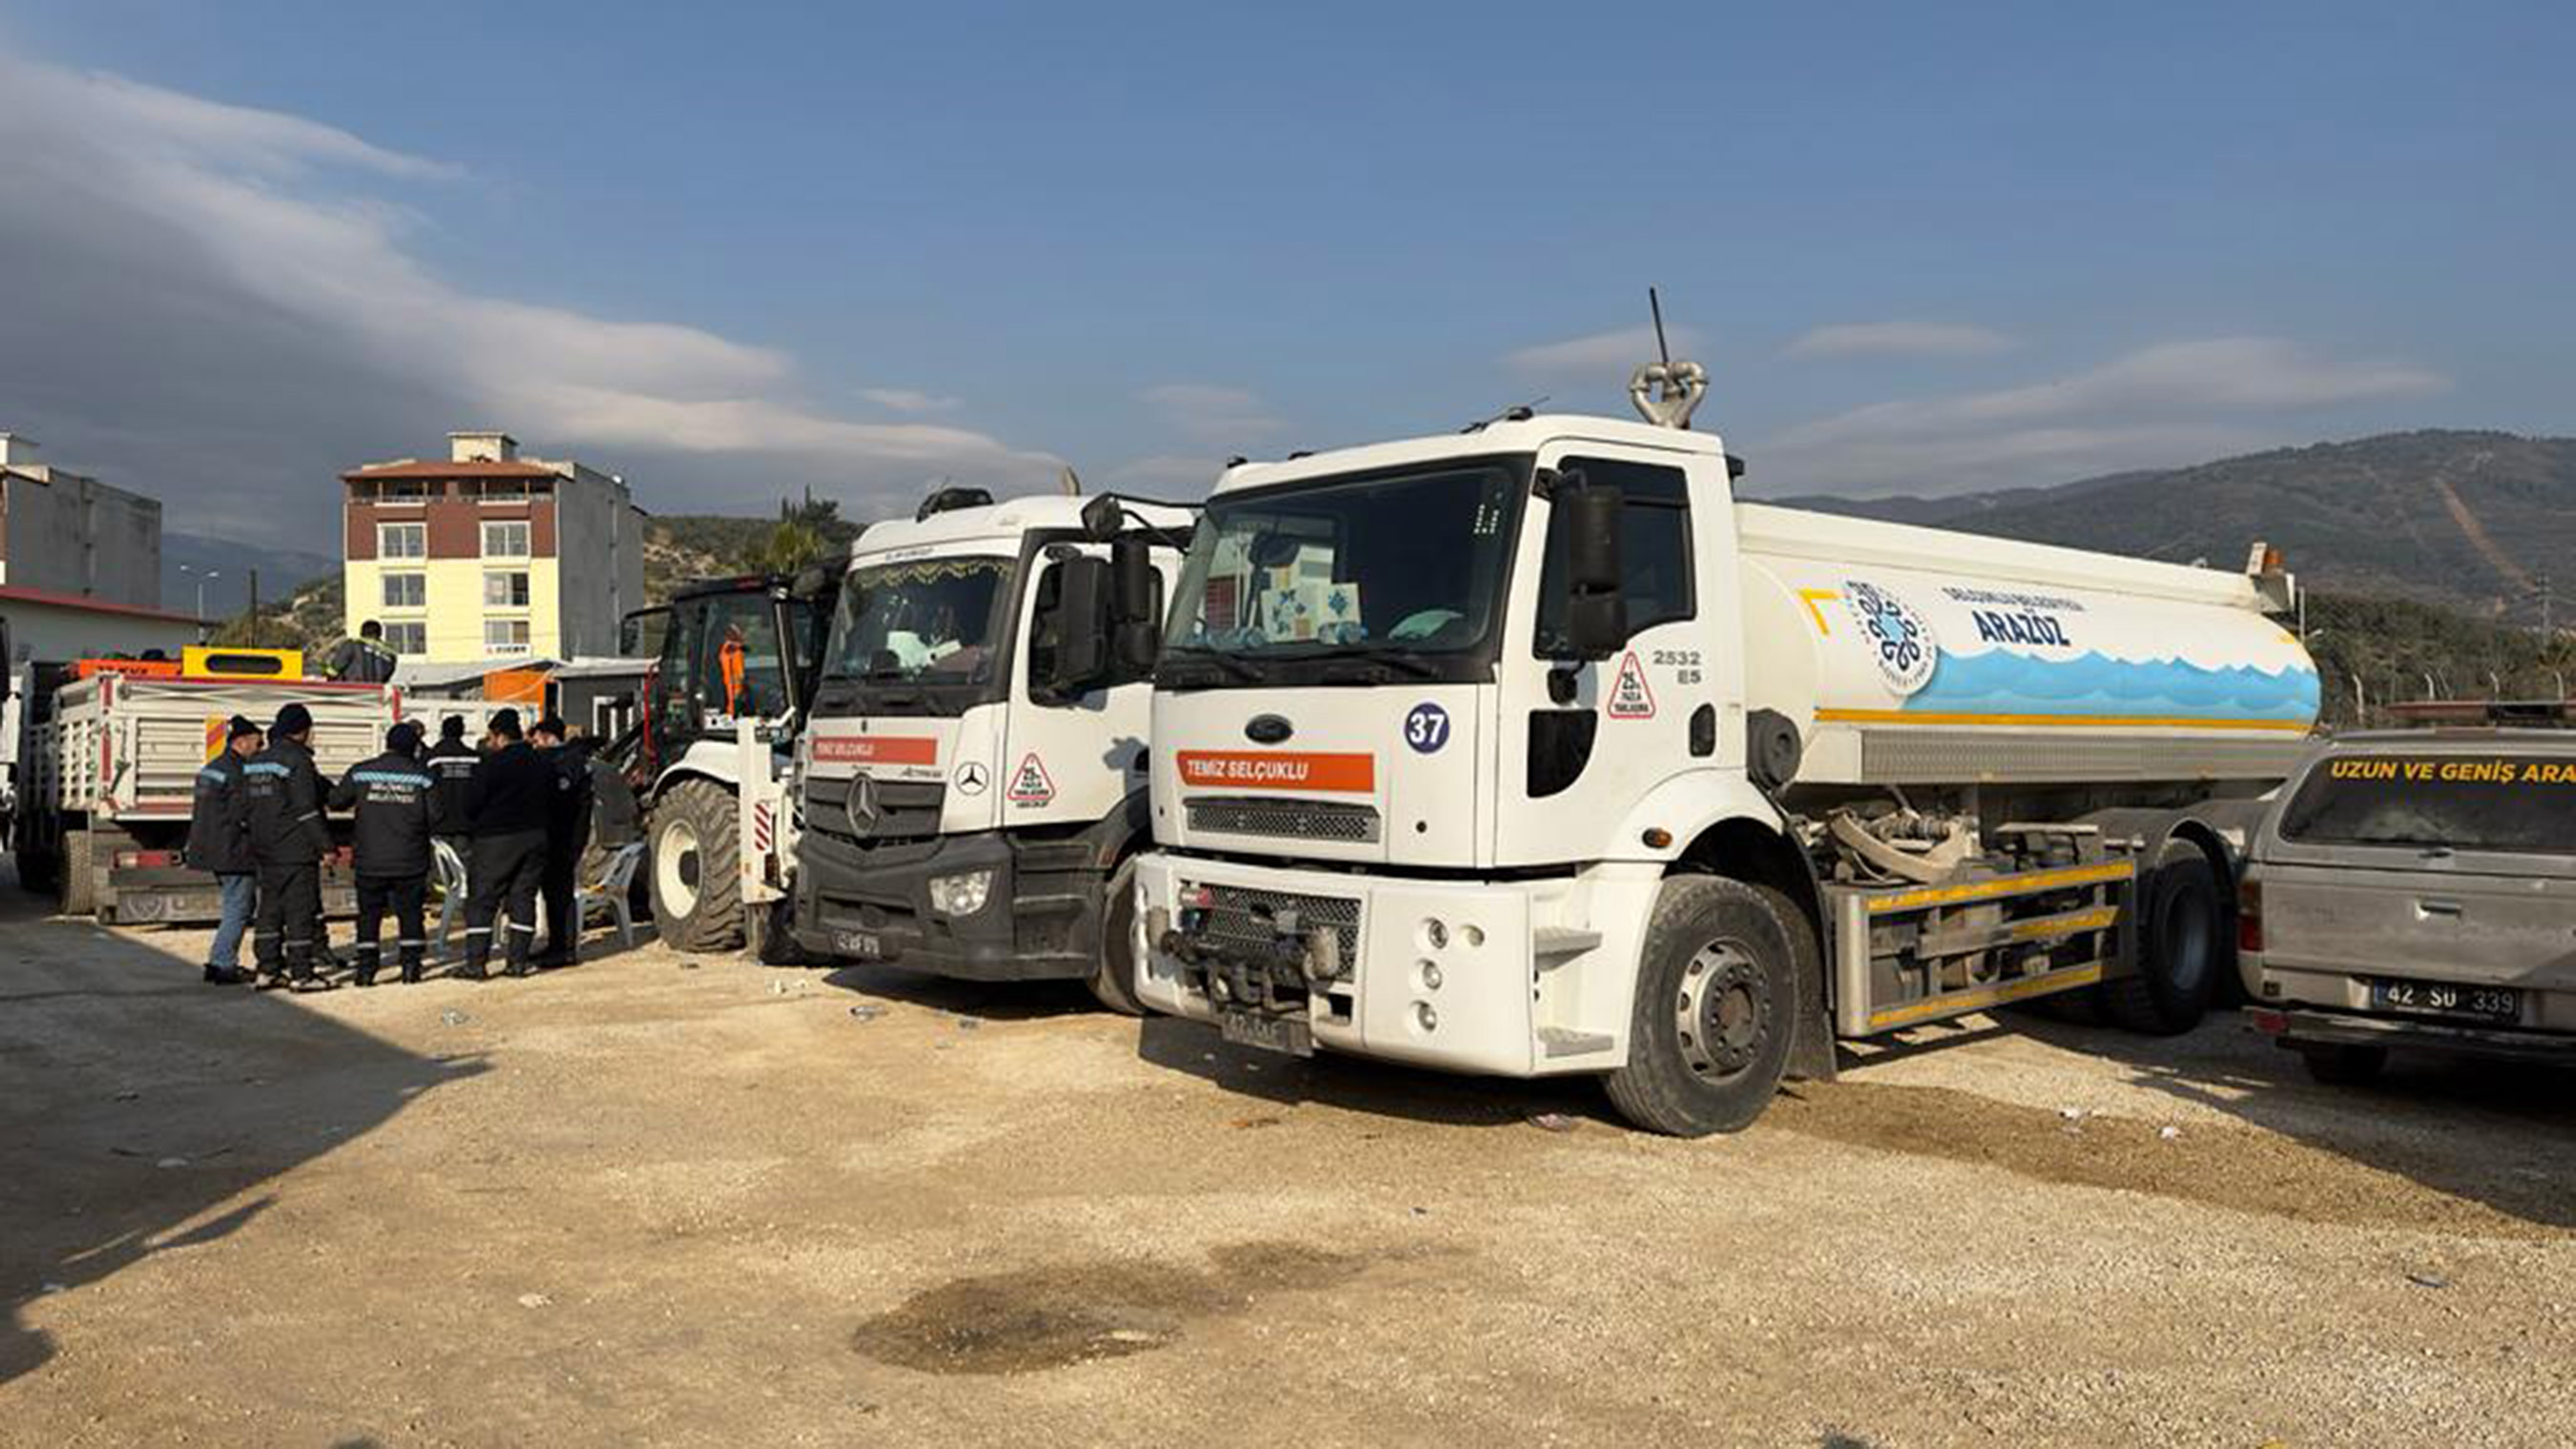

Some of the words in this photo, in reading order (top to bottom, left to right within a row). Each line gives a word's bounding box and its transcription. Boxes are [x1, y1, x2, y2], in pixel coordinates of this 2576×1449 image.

[1652, 650, 1701, 666] 2532
[1677, 670, 1701, 685] E5
[1409, 713, 1444, 743] 37
[1227, 761, 1309, 781] SELÇUKLU
[2331, 761, 2398, 778] UZUN
[2404, 762, 2434, 779] VE
[2440, 759, 2516, 783] GENİŞ
[2388, 983, 2414, 1004] 42
[2430, 985, 2457, 1007] SU
[2473, 990, 2515, 1013] 339
